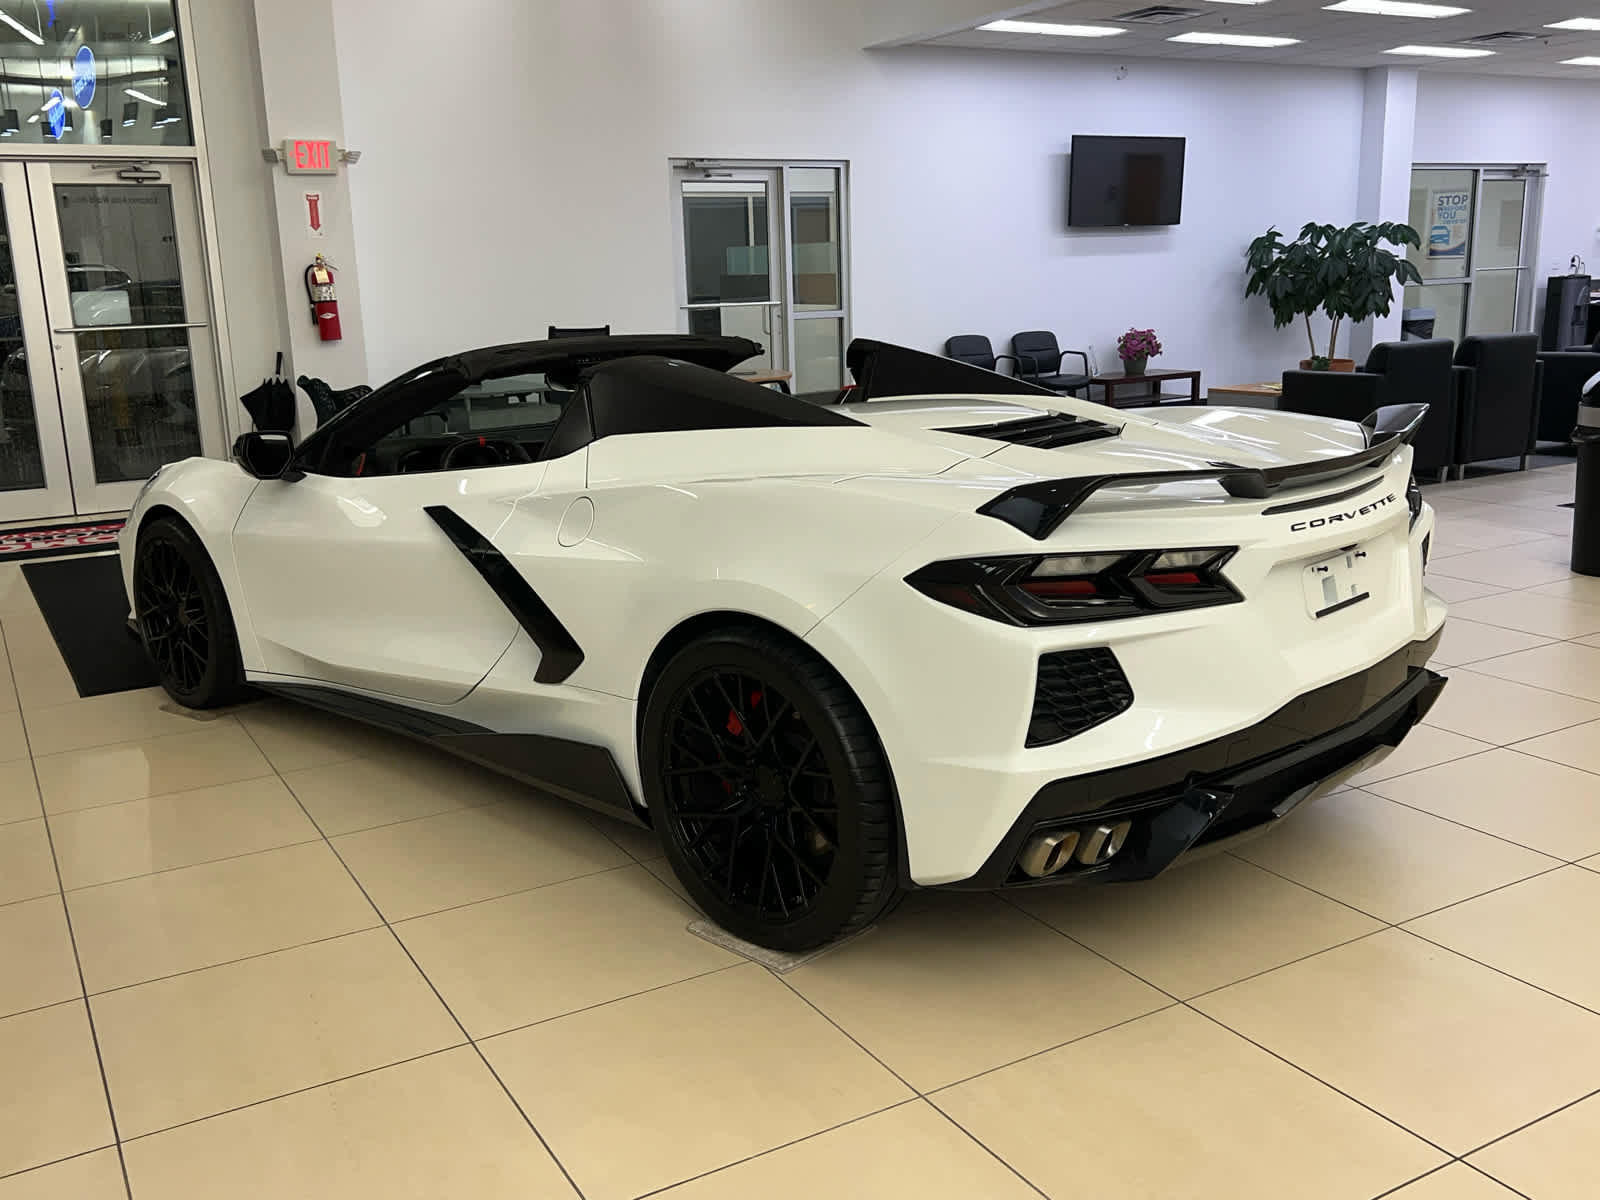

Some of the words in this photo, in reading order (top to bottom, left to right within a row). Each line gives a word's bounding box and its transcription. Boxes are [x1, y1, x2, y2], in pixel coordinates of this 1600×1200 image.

[294, 141, 330, 169] EXIT
[1437, 194, 1468, 206] STOP
[1290, 493, 1396, 532] CORVETTE
